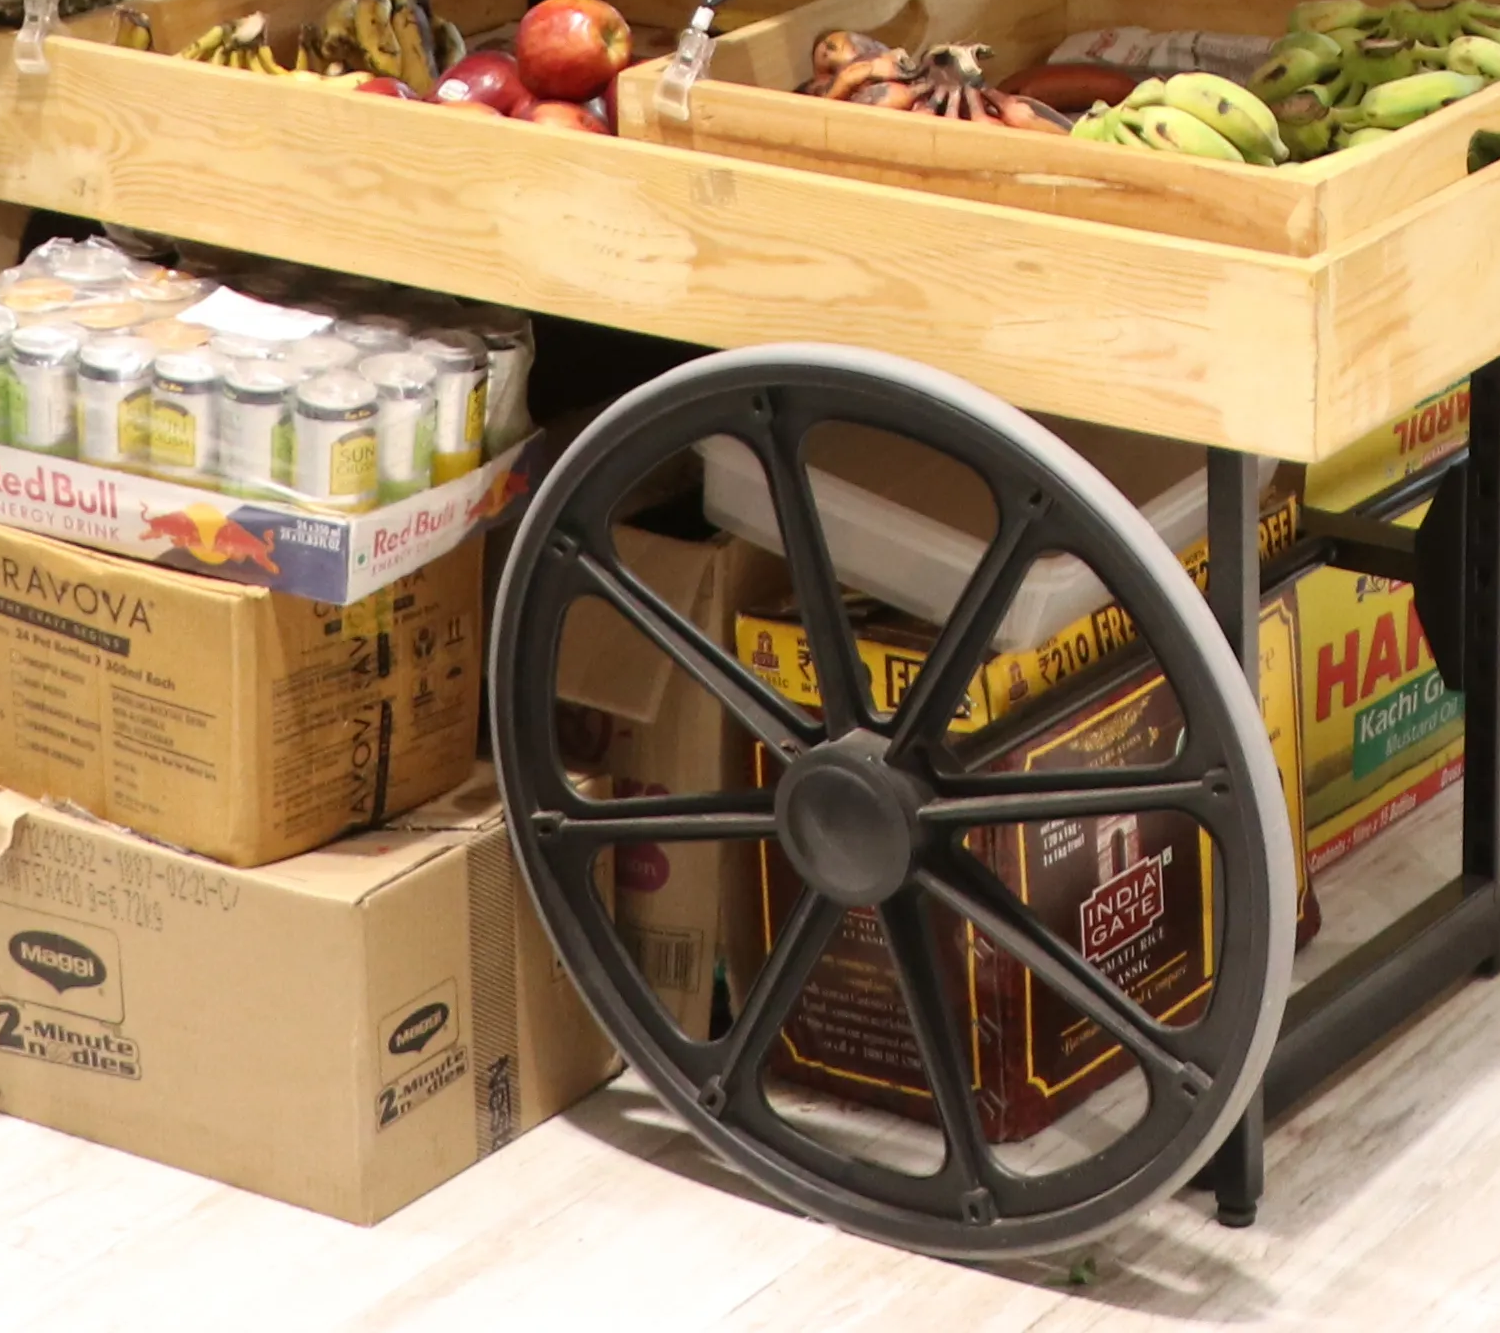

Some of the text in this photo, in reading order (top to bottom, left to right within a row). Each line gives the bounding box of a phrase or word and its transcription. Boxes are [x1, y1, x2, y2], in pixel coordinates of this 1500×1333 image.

[1393, 389, 1470, 456] ARDIL
[53, 471, 119, 520] Bull
[63, 511, 121, 541] DRINK
[372, 499, 456, 560] Red Bull
[1360, 687, 1417, 743] Kachi
[1087, 872, 1156, 926] INDIA
[1090, 899, 1156, 947] GATE
[19, 940, 97, 980] Maggi
